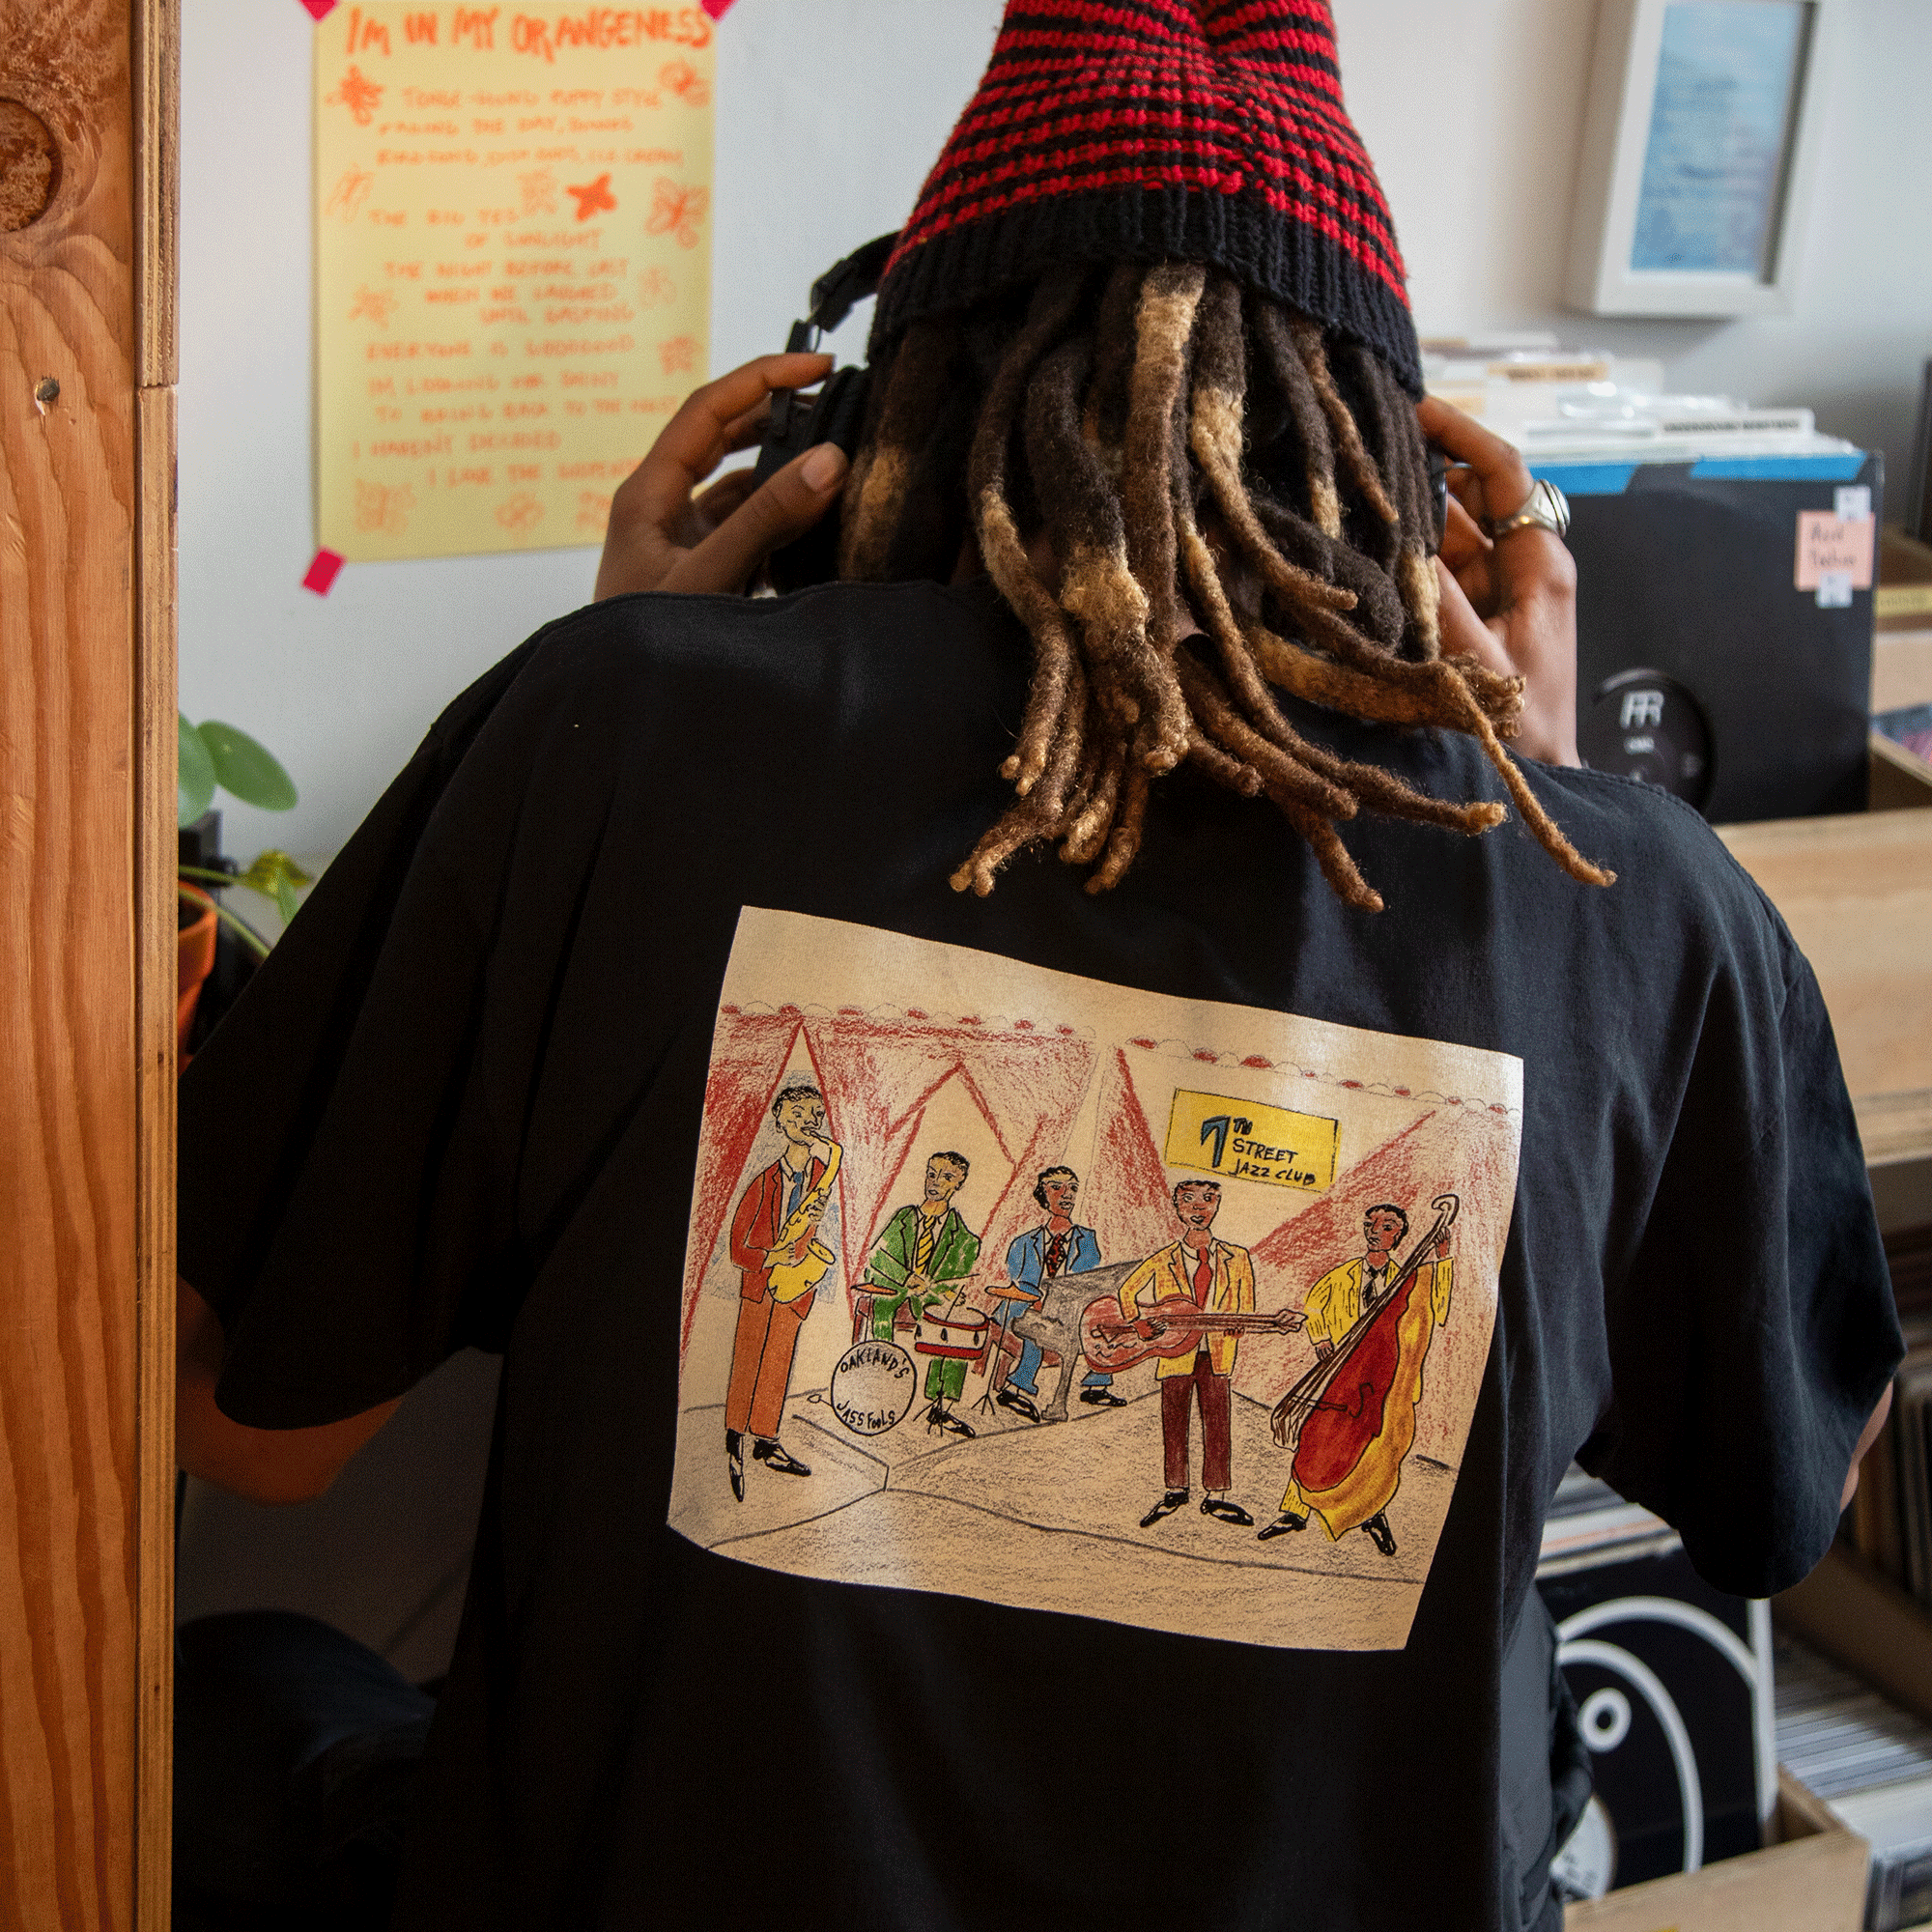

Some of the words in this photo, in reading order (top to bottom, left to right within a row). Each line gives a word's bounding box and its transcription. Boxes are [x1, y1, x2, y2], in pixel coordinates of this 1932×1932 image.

[404, 12, 439, 46] IN
[451, 5, 500, 51] MY
[511, 5, 713, 65] ORANGENESS
[1233, 1137, 1299, 1165] STREET
[1227, 1158, 1271, 1178] JAZZ
[1274, 1167, 1317, 1186] CLUB
[840, 1347, 910, 1378] OAKLAND'S
